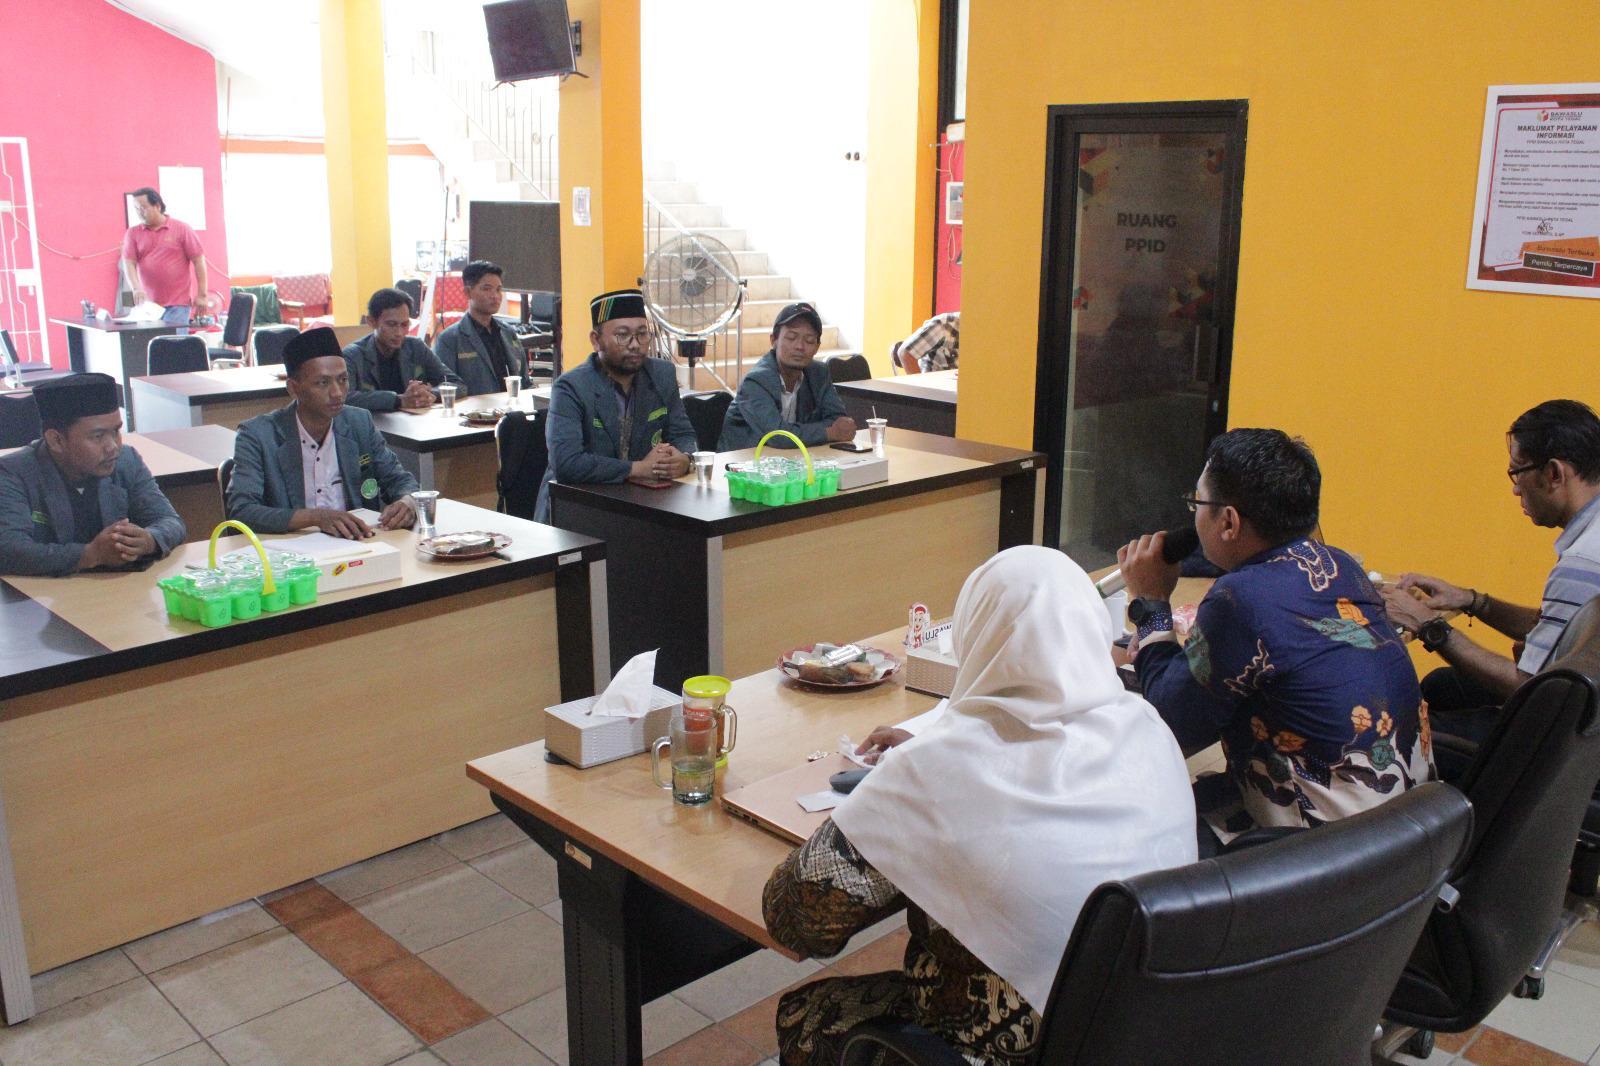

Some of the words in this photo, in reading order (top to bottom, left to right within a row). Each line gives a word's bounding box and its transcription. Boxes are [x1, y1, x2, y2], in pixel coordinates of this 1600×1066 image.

[1116, 212, 1178, 228] RUANG
[1125, 238, 1166, 254] PPID
[1537, 245, 1565, 254] Bawaslu
[1567, 247, 1595, 257] Terbuka
[1531, 259, 1553, 267] Pemilu
[1553, 261, 1588, 272] Terpercaya
